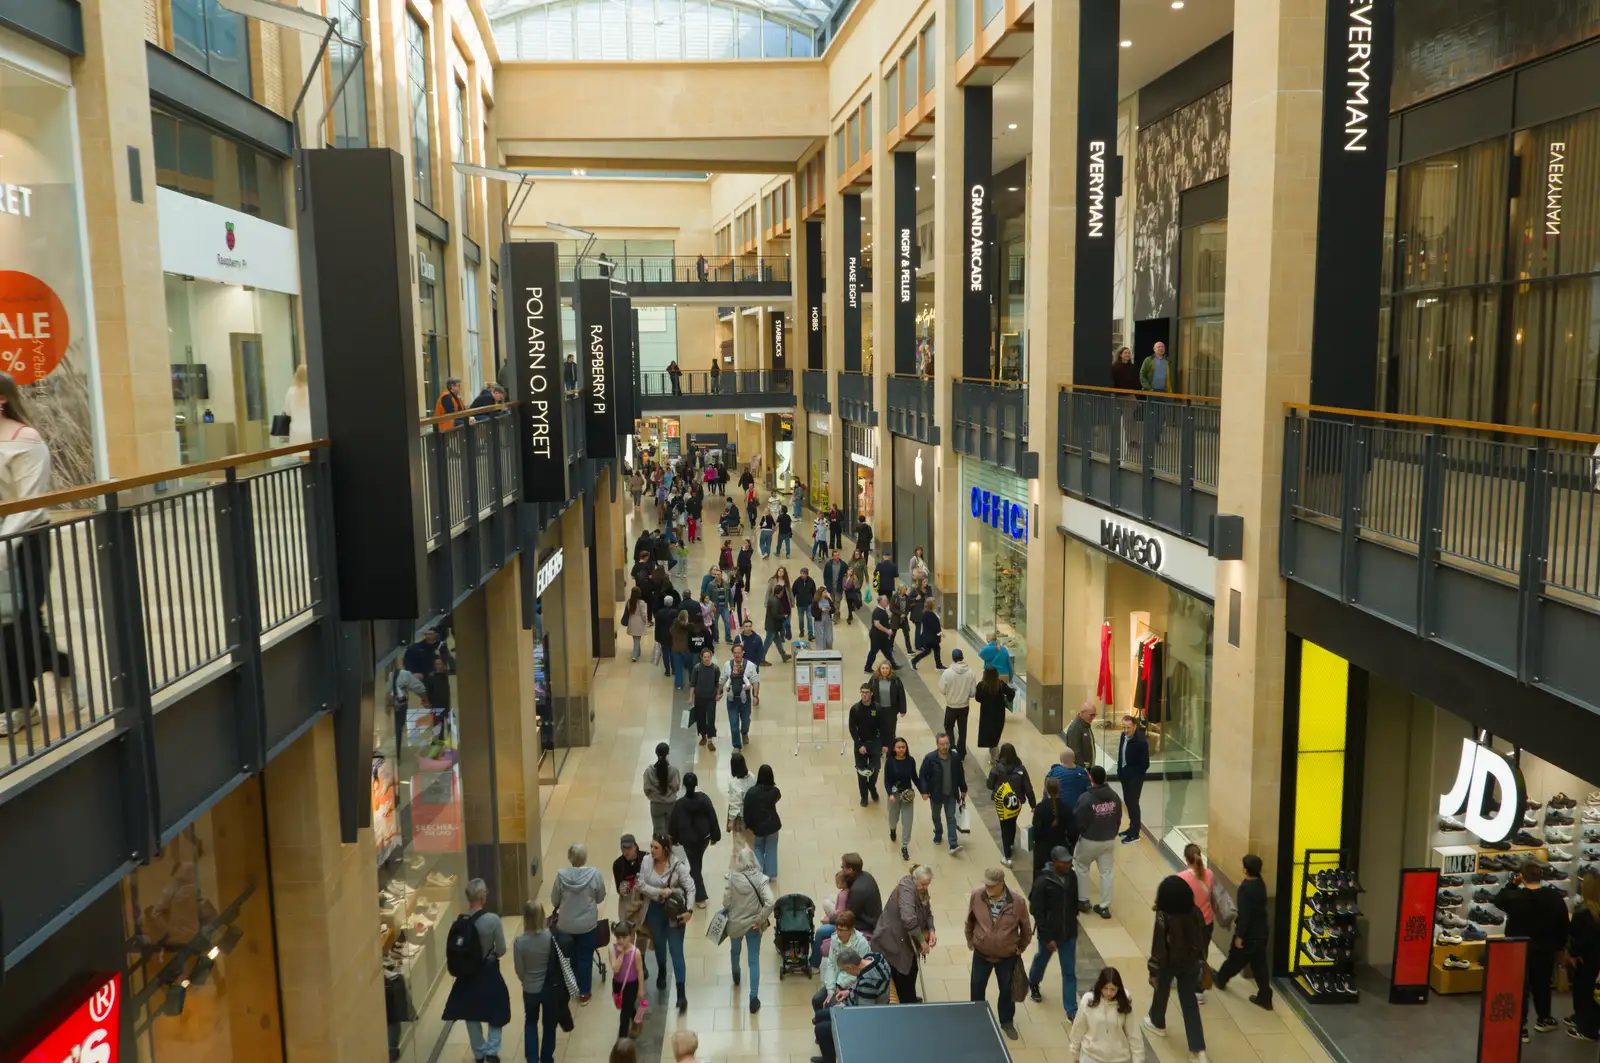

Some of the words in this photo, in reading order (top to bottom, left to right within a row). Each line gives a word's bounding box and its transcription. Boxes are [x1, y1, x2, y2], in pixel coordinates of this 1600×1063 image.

[1344, 0, 1373, 151] VERYMAN
[970, 184, 985, 237] GRAND
[1088, 141, 1106, 238] EVERYMAN
[900, 228, 911, 258] RIGBY
[900, 259, 911, 268] &
[970, 238, 984, 292] ARCADE
[848, 256, 857, 283] PHASE
[900, 269, 911, 303] PELLER
[811, 306, 819, 332] HOBBS
[848, 283, 857, 309] EIGHT
[525, 286, 548, 371] POLARN
[775, 319, 783, 358] STARBUCKS
[590, 324, 605, 402] RASPBERRY
[530, 399, 551, 460] PYRET
[593, 403, 606, 414] PI
[970, 486, 1029, 545] OFFIC
[1099, 518, 1163, 572] MANGO
[1006, 795, 1018, 808] JD
[1439, 737, 1518, 843] JD
[1445, 855, 1463, 873] MAX
[1464, 855, 1475, 872] 95
